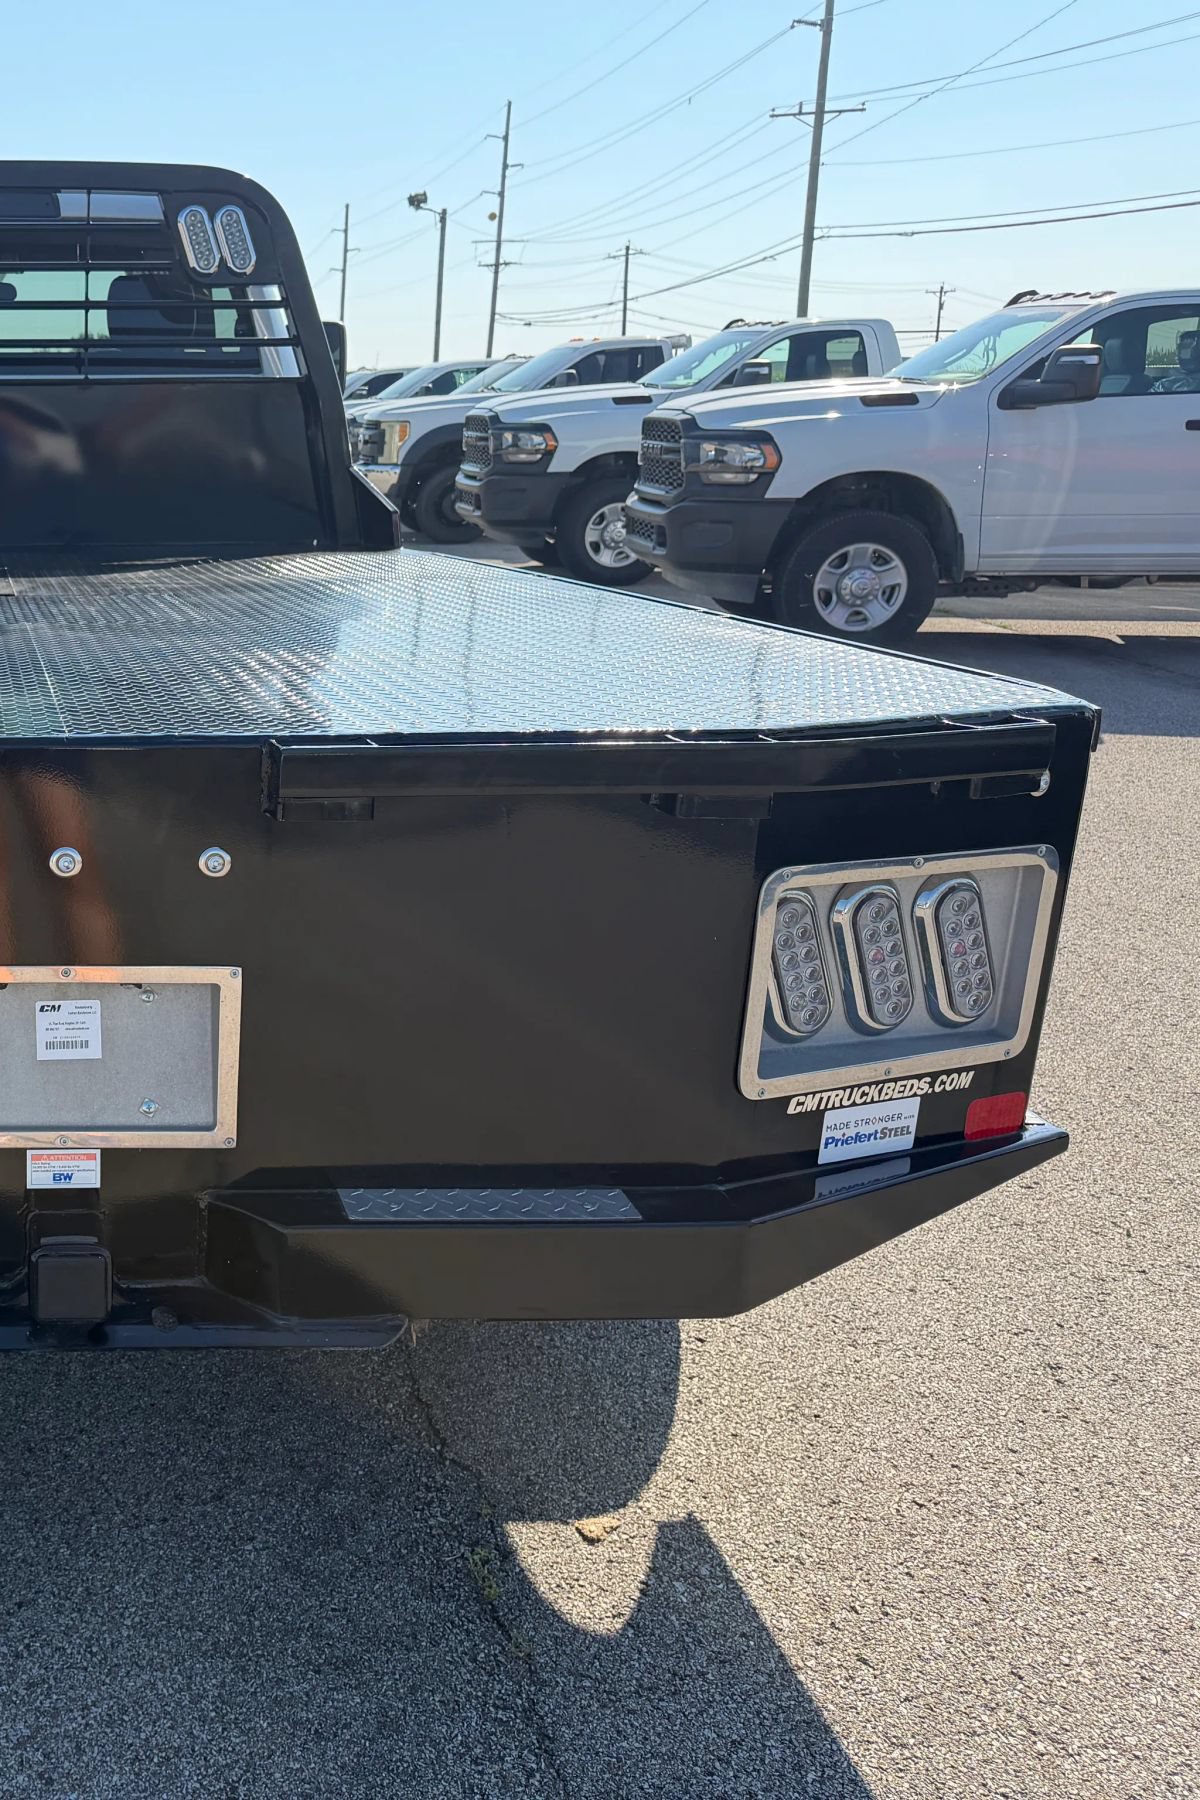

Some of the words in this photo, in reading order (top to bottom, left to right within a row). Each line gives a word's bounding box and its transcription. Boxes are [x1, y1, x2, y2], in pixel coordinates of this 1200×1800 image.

[787, 1071, 975, 1115] CMTRUCKBEDS.COM
[825, 1121, 851, 1132] MADE
[854, 1113, 903, 1128] STRONGER
